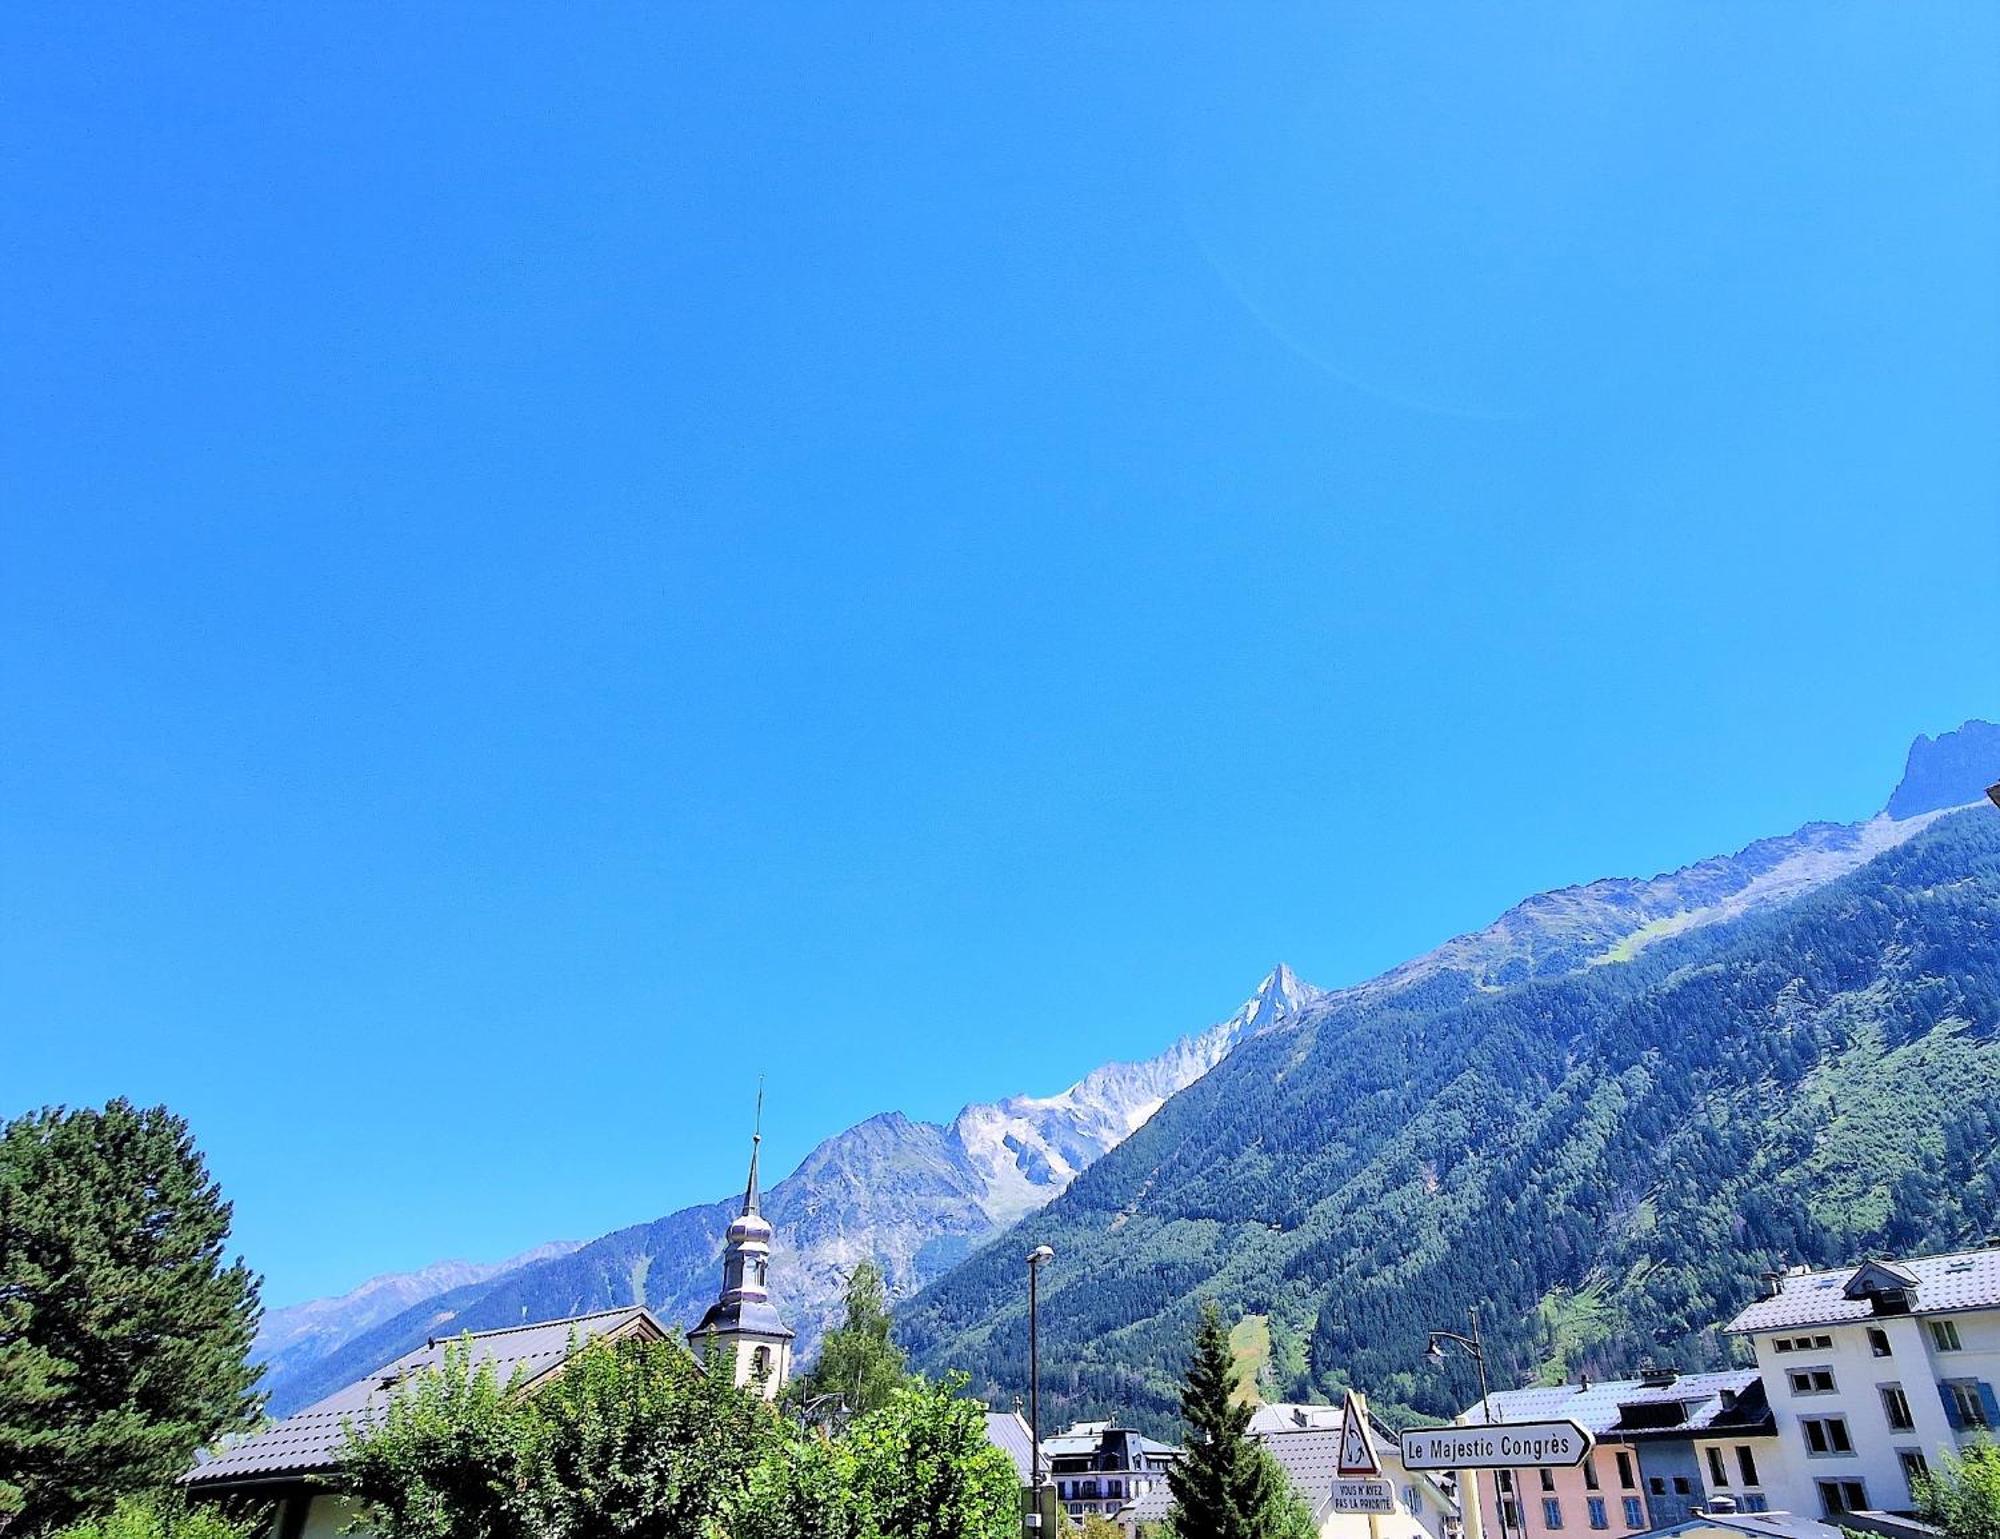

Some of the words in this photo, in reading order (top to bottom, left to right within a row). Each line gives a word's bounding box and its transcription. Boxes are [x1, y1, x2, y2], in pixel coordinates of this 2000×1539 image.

[1408, 1441, 1423, 1459] Le
[1430, 1438, 1494, 1462] Majestic
[1501, 1433, 1569, 1460] Congrès
[1340, 1485, 1357, 1496] VOUS
[1335, 1498, 1348, 1509] PAS
[1350, 1499, 1358, 1509] LA
[1360, 1496, 1391, 1510] PRIORITÉ
